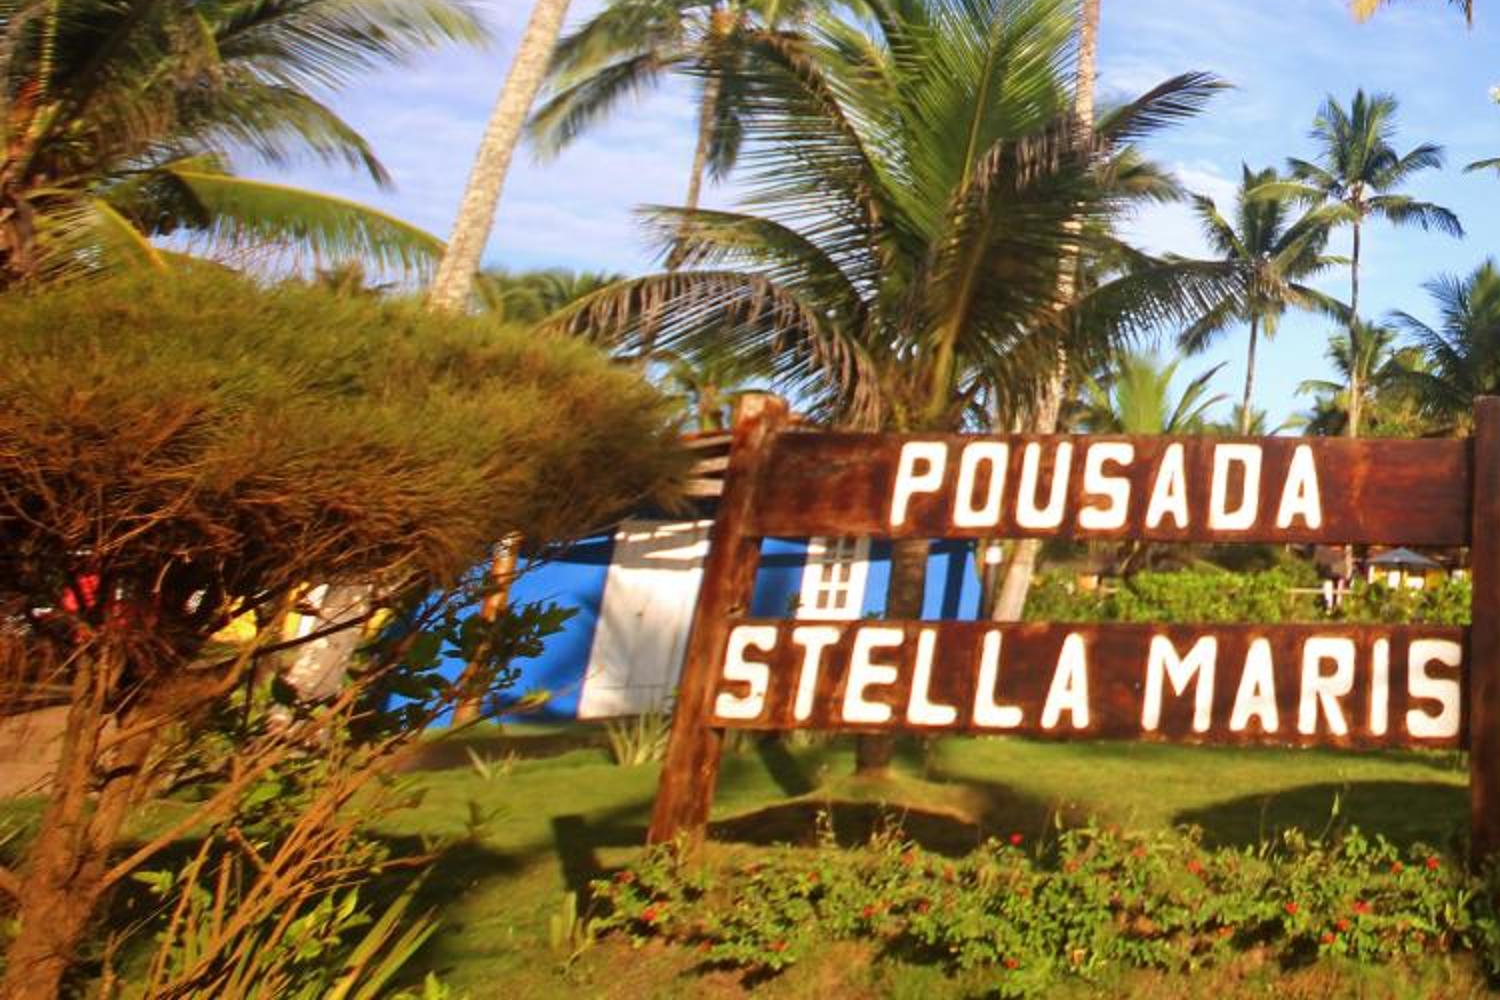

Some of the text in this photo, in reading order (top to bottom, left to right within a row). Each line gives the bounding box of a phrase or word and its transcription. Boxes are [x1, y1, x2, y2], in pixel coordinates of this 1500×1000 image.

[888, 440, 1323, 531] POUSADA
[714, 625, 1462, 738] STELLA MARIS
